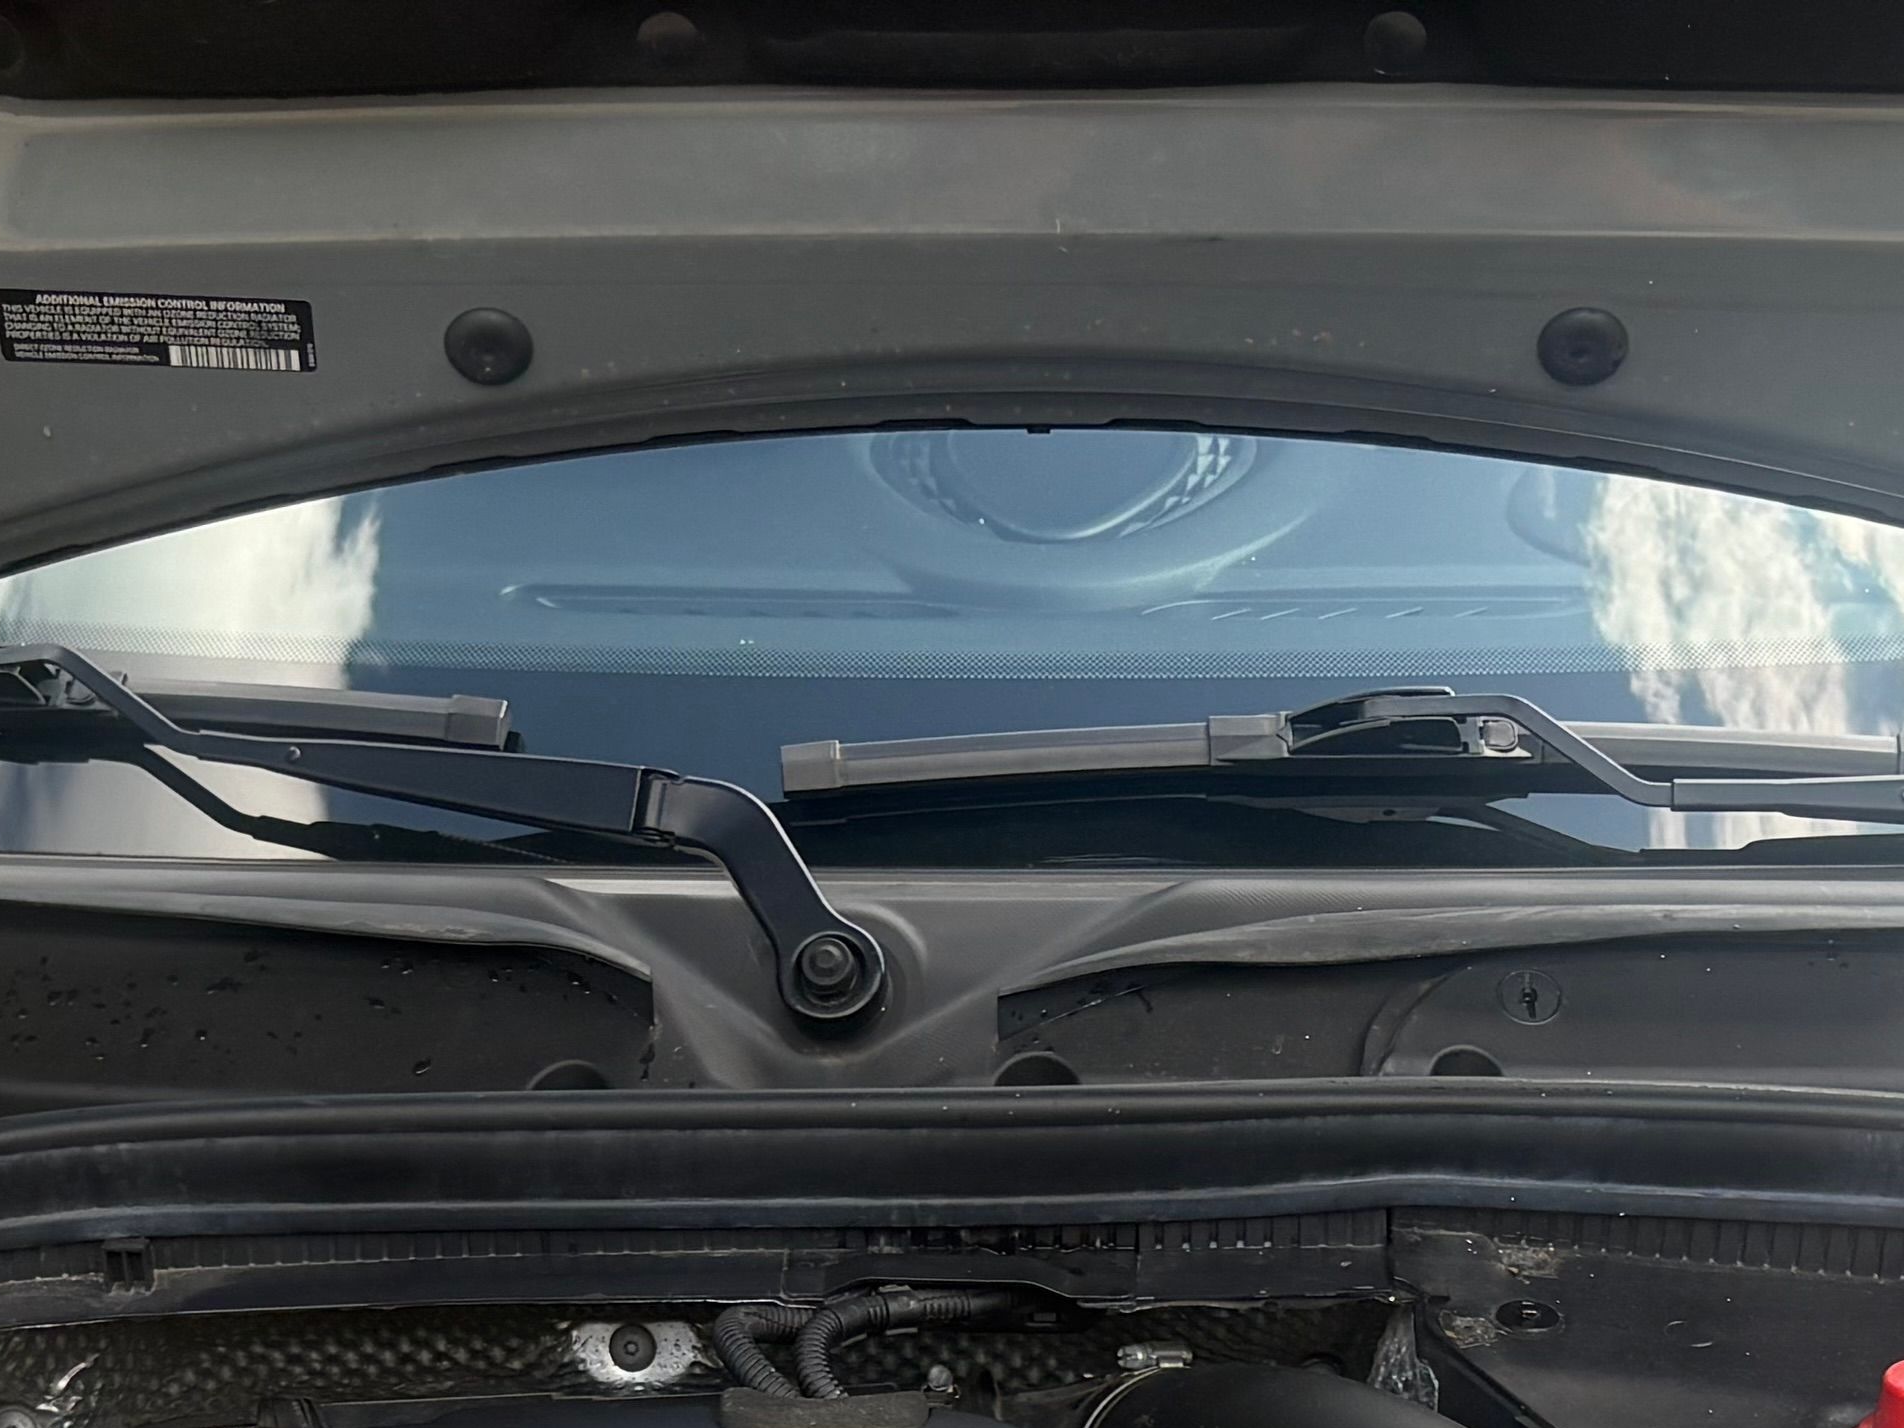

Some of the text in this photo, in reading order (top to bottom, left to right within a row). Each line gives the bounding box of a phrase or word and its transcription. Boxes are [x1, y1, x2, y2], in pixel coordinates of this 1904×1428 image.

[35, 293, 286, 314] ADDITIONAL EMISSION CONTROL INFORMATION
[195, 311, 250, 321] REDUCTION
[250, 313, 297, 322] RADIATOR
[159, 335, 209, 346] POLLUTION
